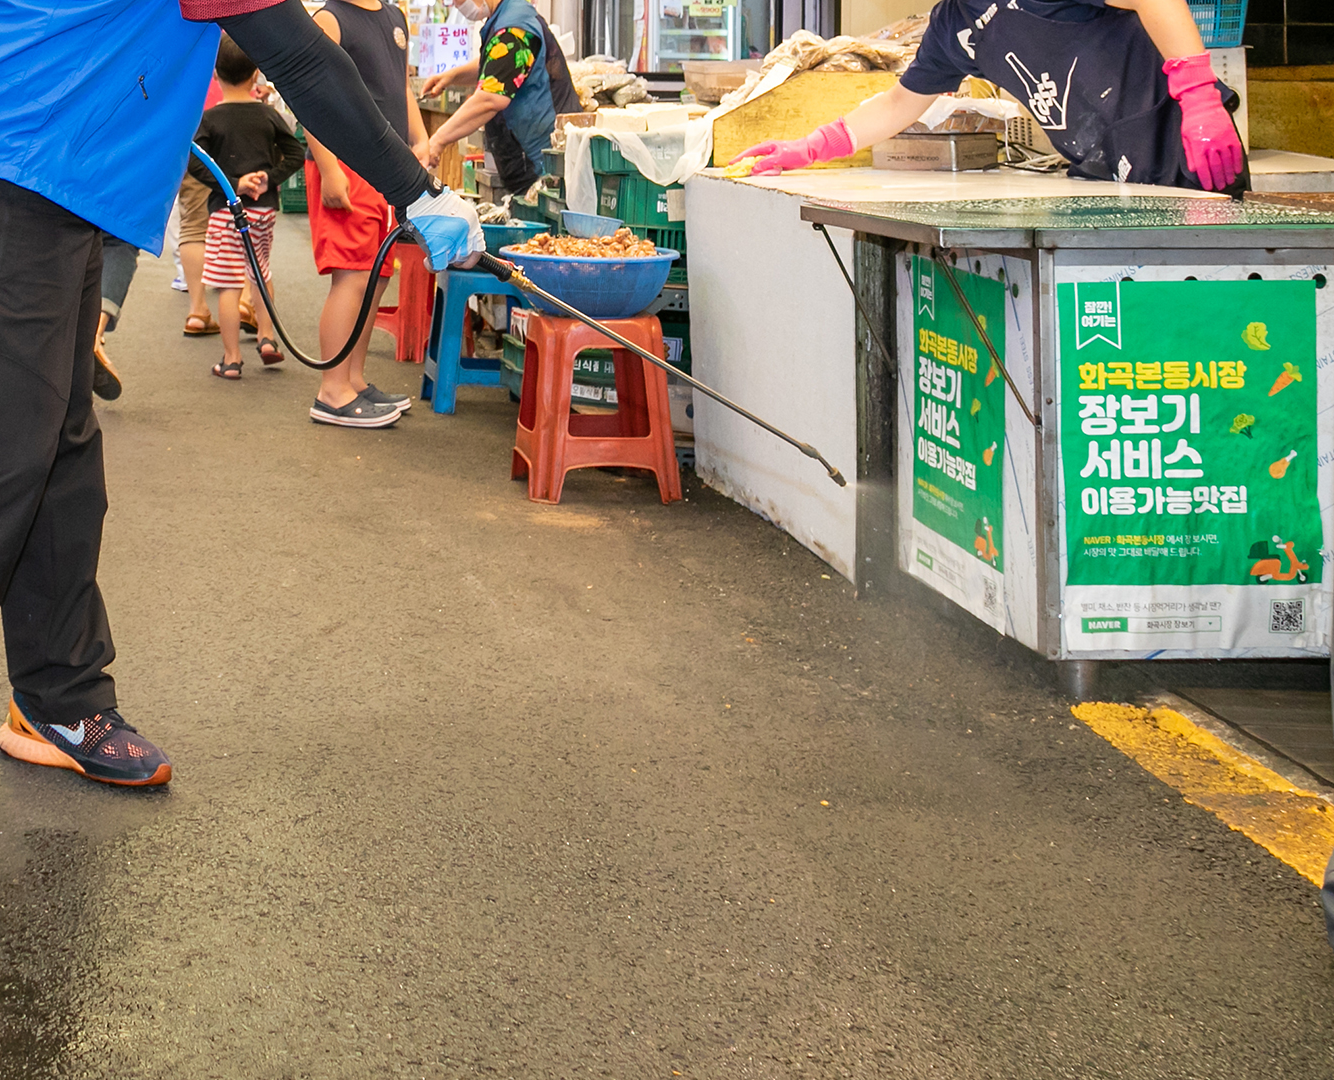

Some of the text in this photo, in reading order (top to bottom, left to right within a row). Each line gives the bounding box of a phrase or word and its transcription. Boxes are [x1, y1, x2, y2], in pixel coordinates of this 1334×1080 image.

[1081, 315, 1116, 328] 여기는
[1084, 301, 1112, 314] 잠깐!
[918, 327, 978, 375] 화곡본동시장
[918, 356, 962, 409] 장보기
[1078, 360, 1247, 390] 화곡본동시장
[918, 396, 961, 450] 서비스
[1078, 393, 1201, 436] 장보기
[917, 436, 977, 491] 이용가능맛집
[1080, 438, 1204, 480] 서비스
[1081, 485, 1248, 516] 이용가능맛집
[1083, 536, 1112, 545] NAVER
[1116, 535, 1165, 546] 화곡본동시장
[1166, 534, 1184, 544] 에서
[1083, 548, 1107, 557] 시장의
[1108, 548, 1117, 557] 맛
[1118, 548, 1143, 557] 그대로
[1144, 547, 1169, 557] 배달해
[1116, 603, 1132, 612] 반찬
[1133, 603, 1141, 612] 등
[1088, 619, 1195, 629] NAVER 화곡시장 장보기
